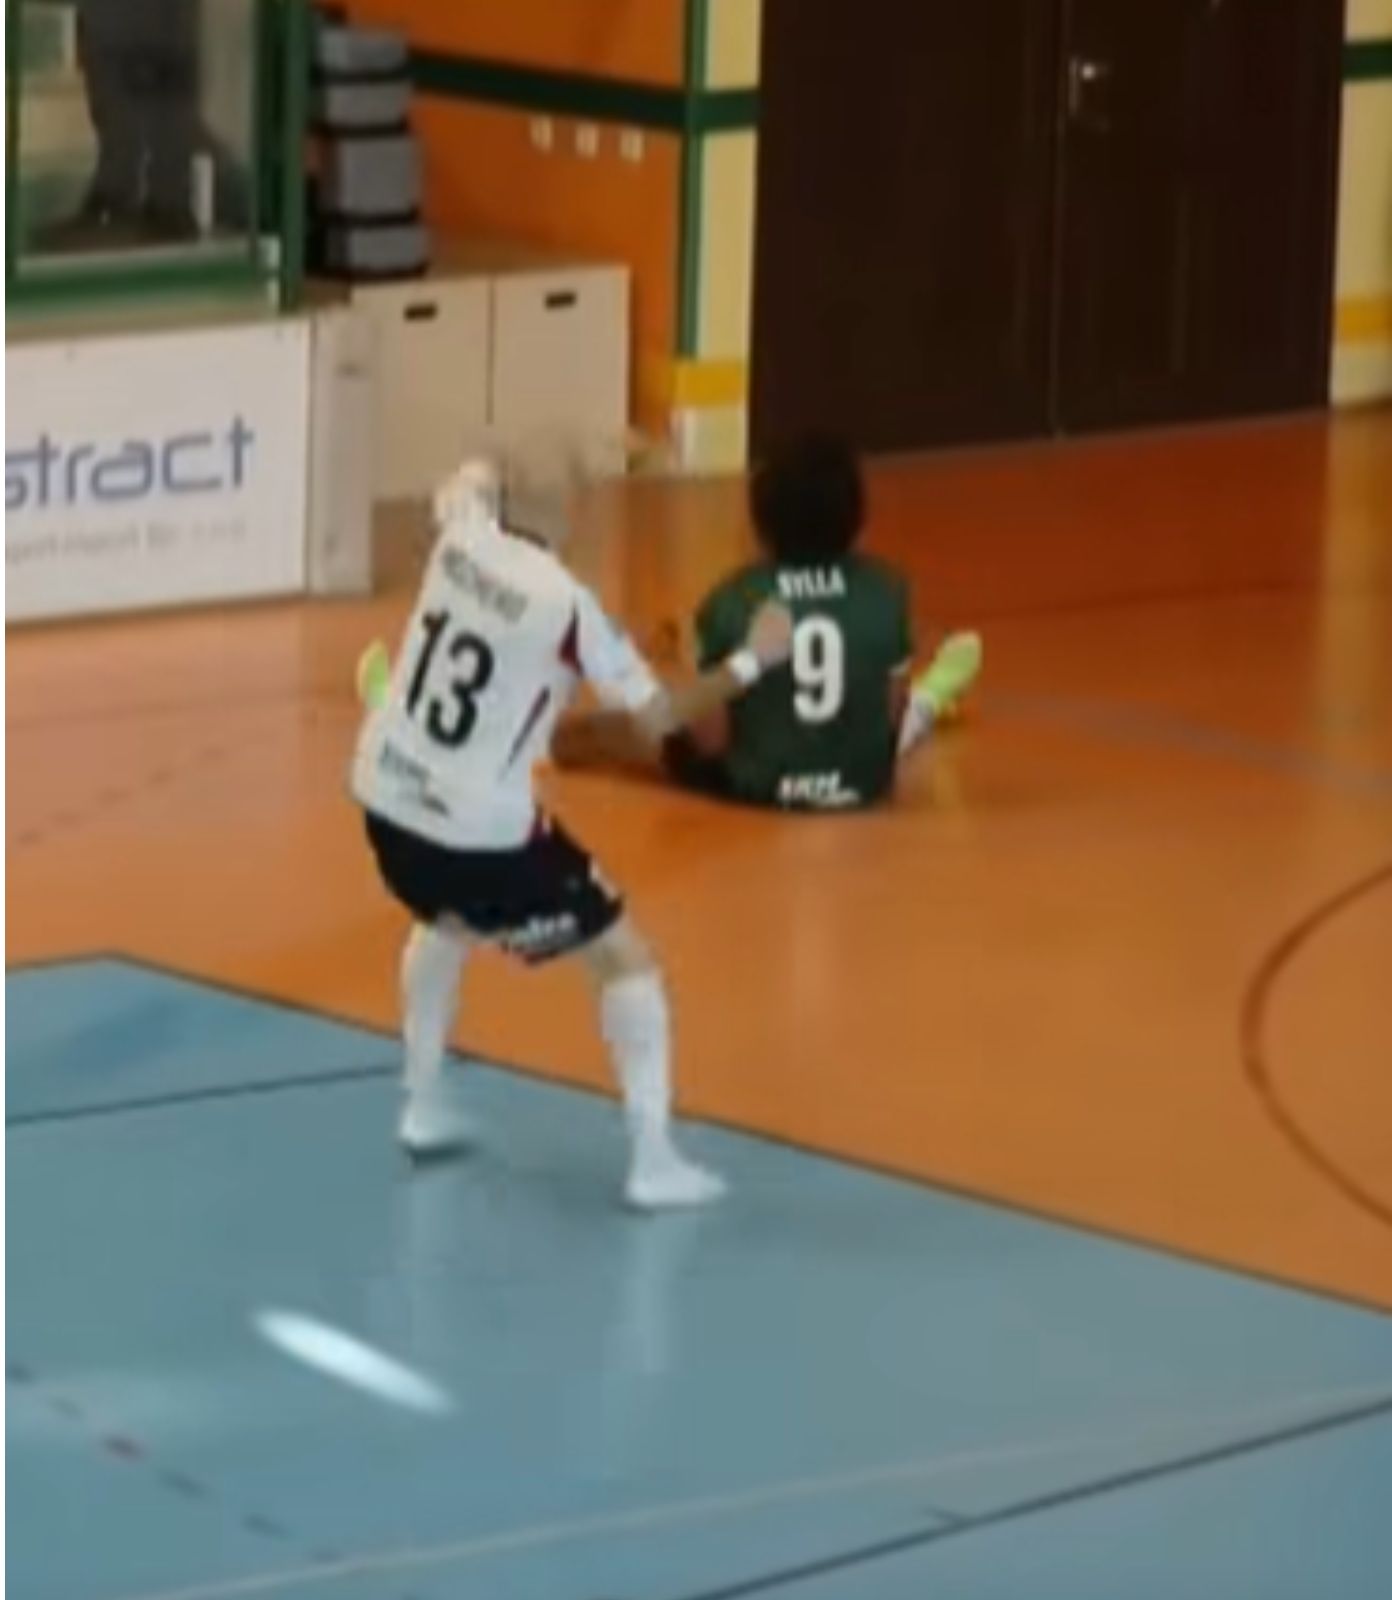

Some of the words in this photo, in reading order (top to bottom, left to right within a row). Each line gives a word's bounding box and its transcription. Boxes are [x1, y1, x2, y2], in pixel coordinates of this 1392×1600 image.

[776, 566, 846, 598] SYLLA
[404, 607, 495, 750] 13
[792, 613, 844, 723] 9
